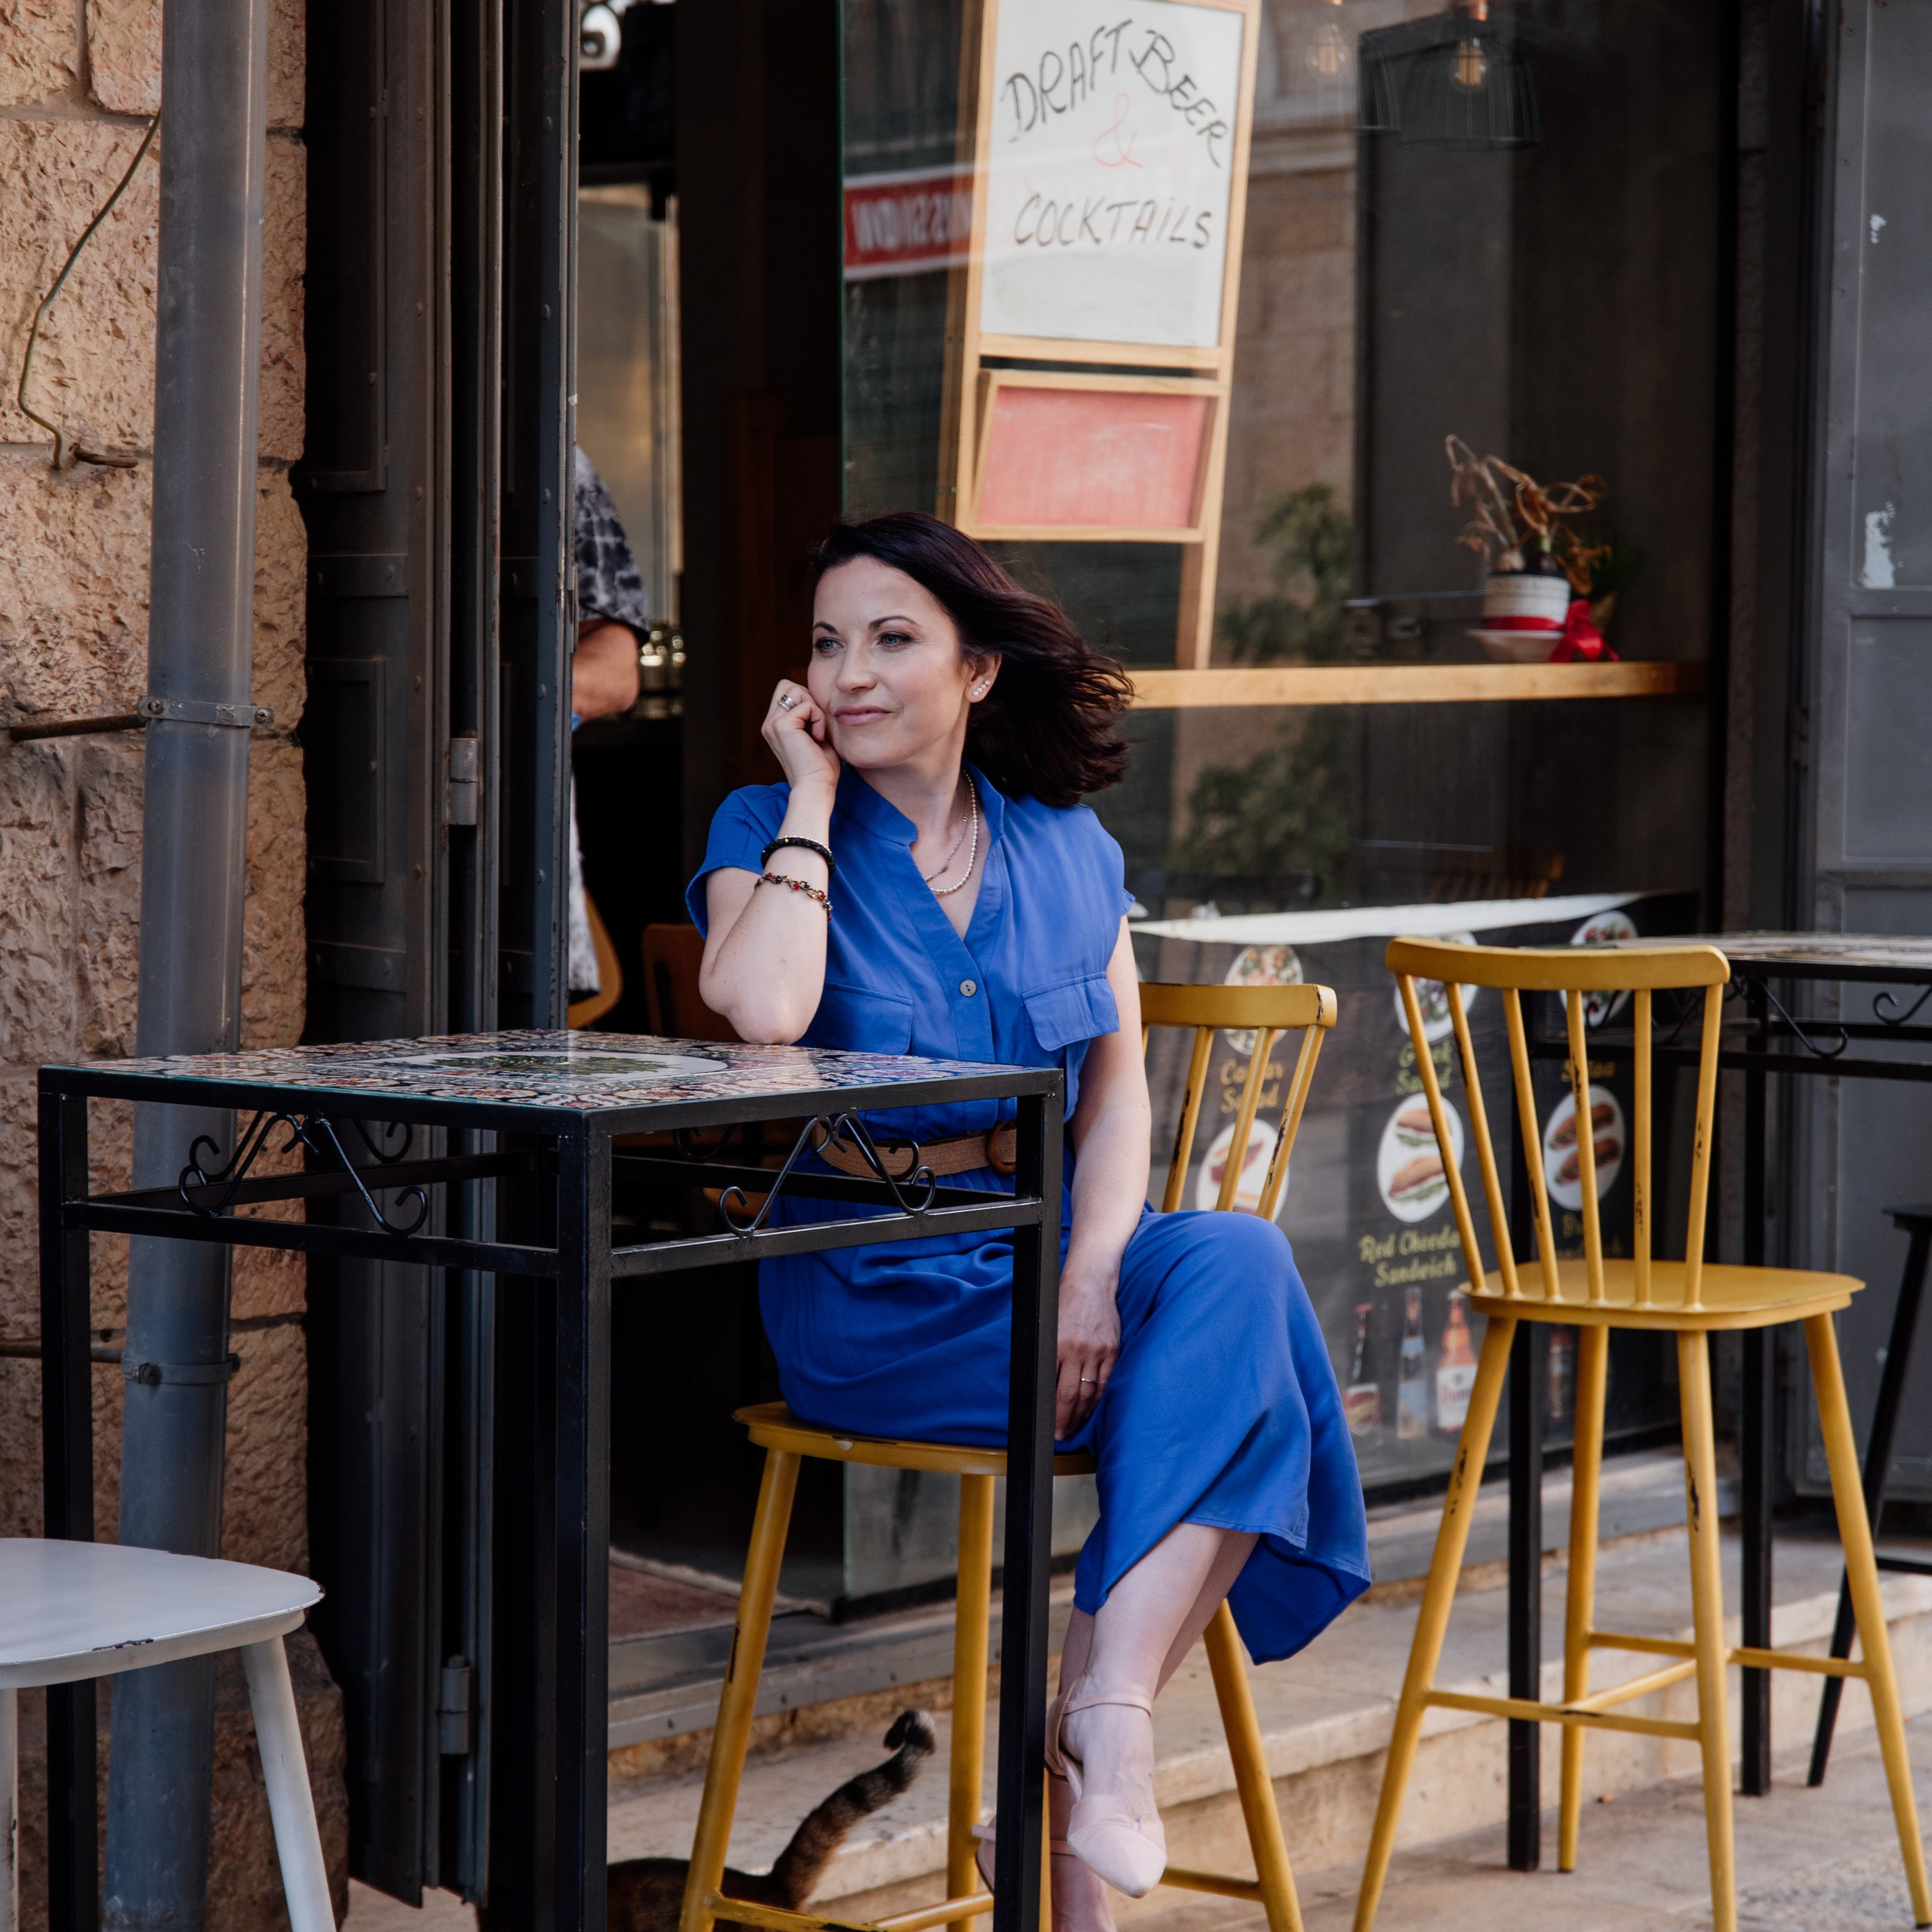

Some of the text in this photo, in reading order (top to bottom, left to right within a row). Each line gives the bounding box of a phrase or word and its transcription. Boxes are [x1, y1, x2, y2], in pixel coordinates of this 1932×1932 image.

[1001, 19, 1229, 168] DRAFT BEER
[1091, 93, 1143, 168] &
[1398, 1039, 1453, 1067] Gek
[1220, 1059, 1284, 1084] Caar
[1395, 1066, 1452, 1095] Sad
[1220, 1082, 1280, 1113] Sad
[1374, 1251, 1457, 1287] Sandwich
